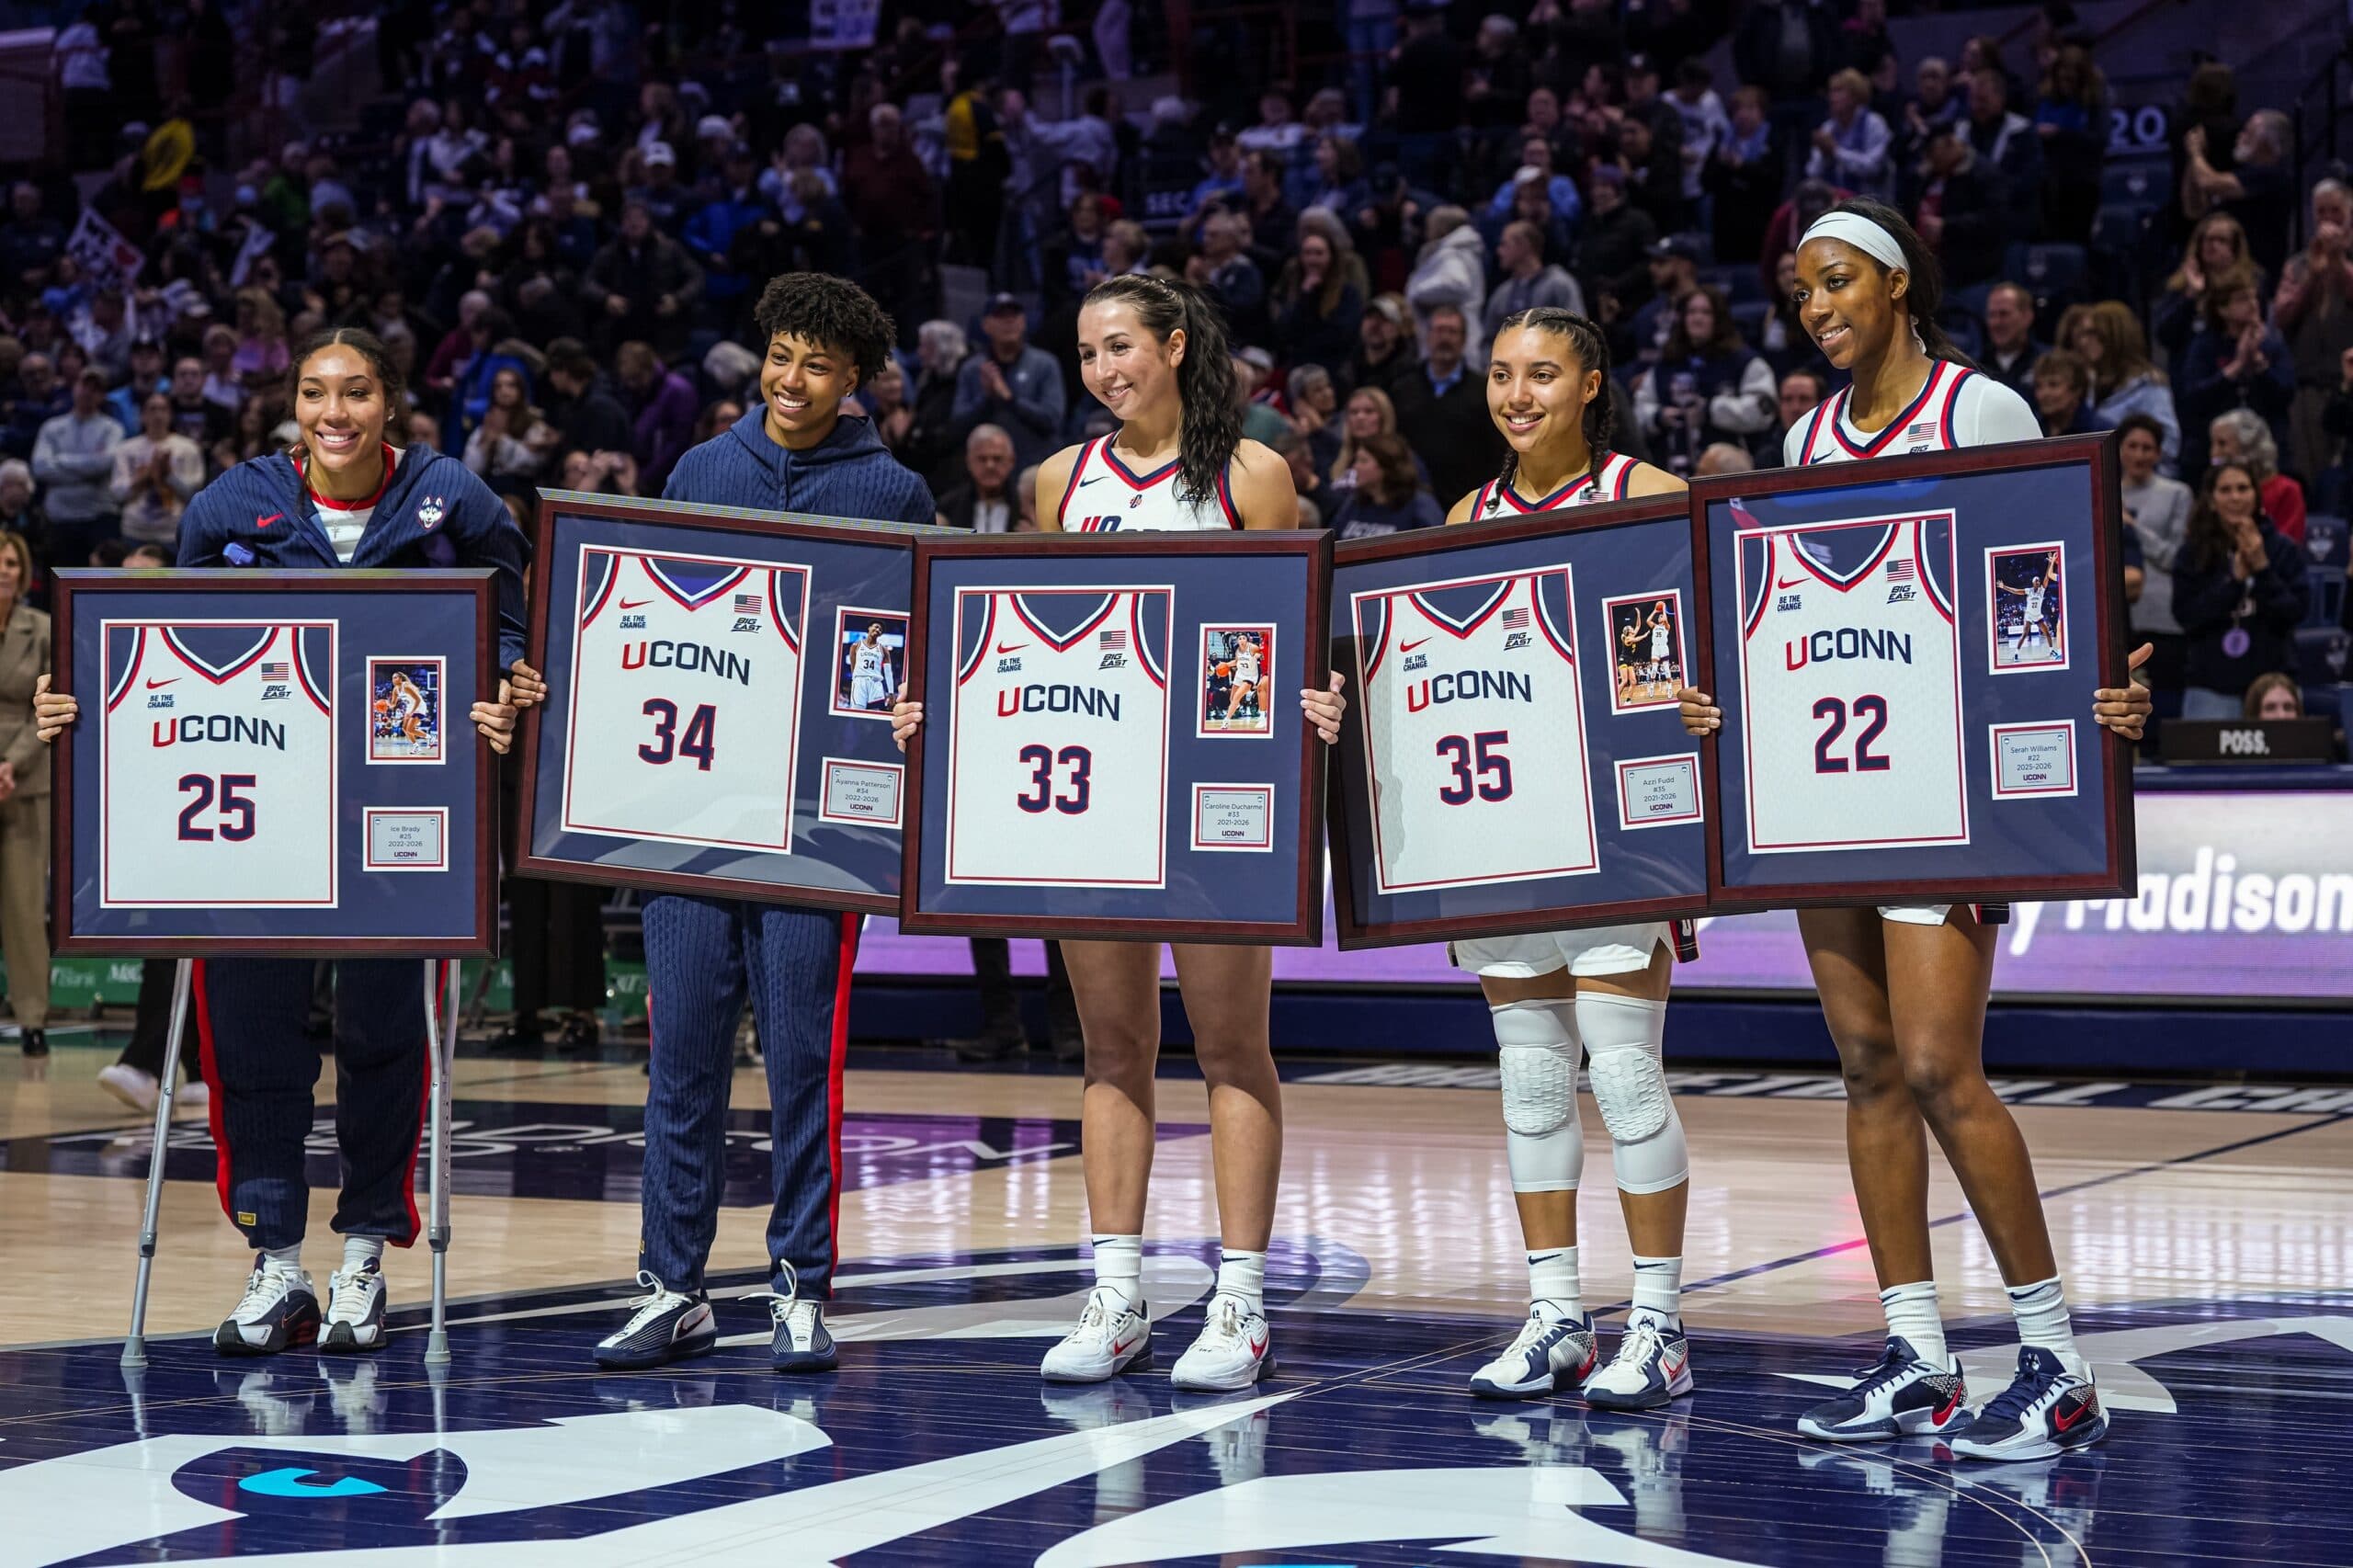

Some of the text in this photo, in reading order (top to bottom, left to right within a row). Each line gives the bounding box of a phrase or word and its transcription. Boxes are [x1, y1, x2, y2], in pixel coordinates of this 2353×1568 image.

[1778, 602, 1802, 612] CHANGE
[1789, 595, 1802, 603] THE
[733, 623, 763, 631] EAST
[1506, 638, 1532, 647] EAST
[1507, 632, 1527, 641] BIG
[1785, 627, 1912, 671] UCONN
[621, 640, 750, 686] UCONN
[863, 660, 875, 670] 34
[996, 664, 1022, 674] CHANGE
[1403, 660, 1428, 671] CHANGE
[1407, 670, 1532, 713] UCONN
[996, 684, 1120, 722] UCONN
[153, 714, 285, 751] UCONN
[638, 698, 716, 772] 34
[1813, 694, 1890, 774] 22
[2219, 730, 2270, 755] POSS.
[1436, 730, 1513, 806] 35
[860, 780, 890, 789] Patterson
[1017, 744, 1092, 815] 33
[846, 794, 879, 802] 2022-2026
[1643, 792, 1677, 801] 2021-2026
[177, 773, 256, 842] 25
